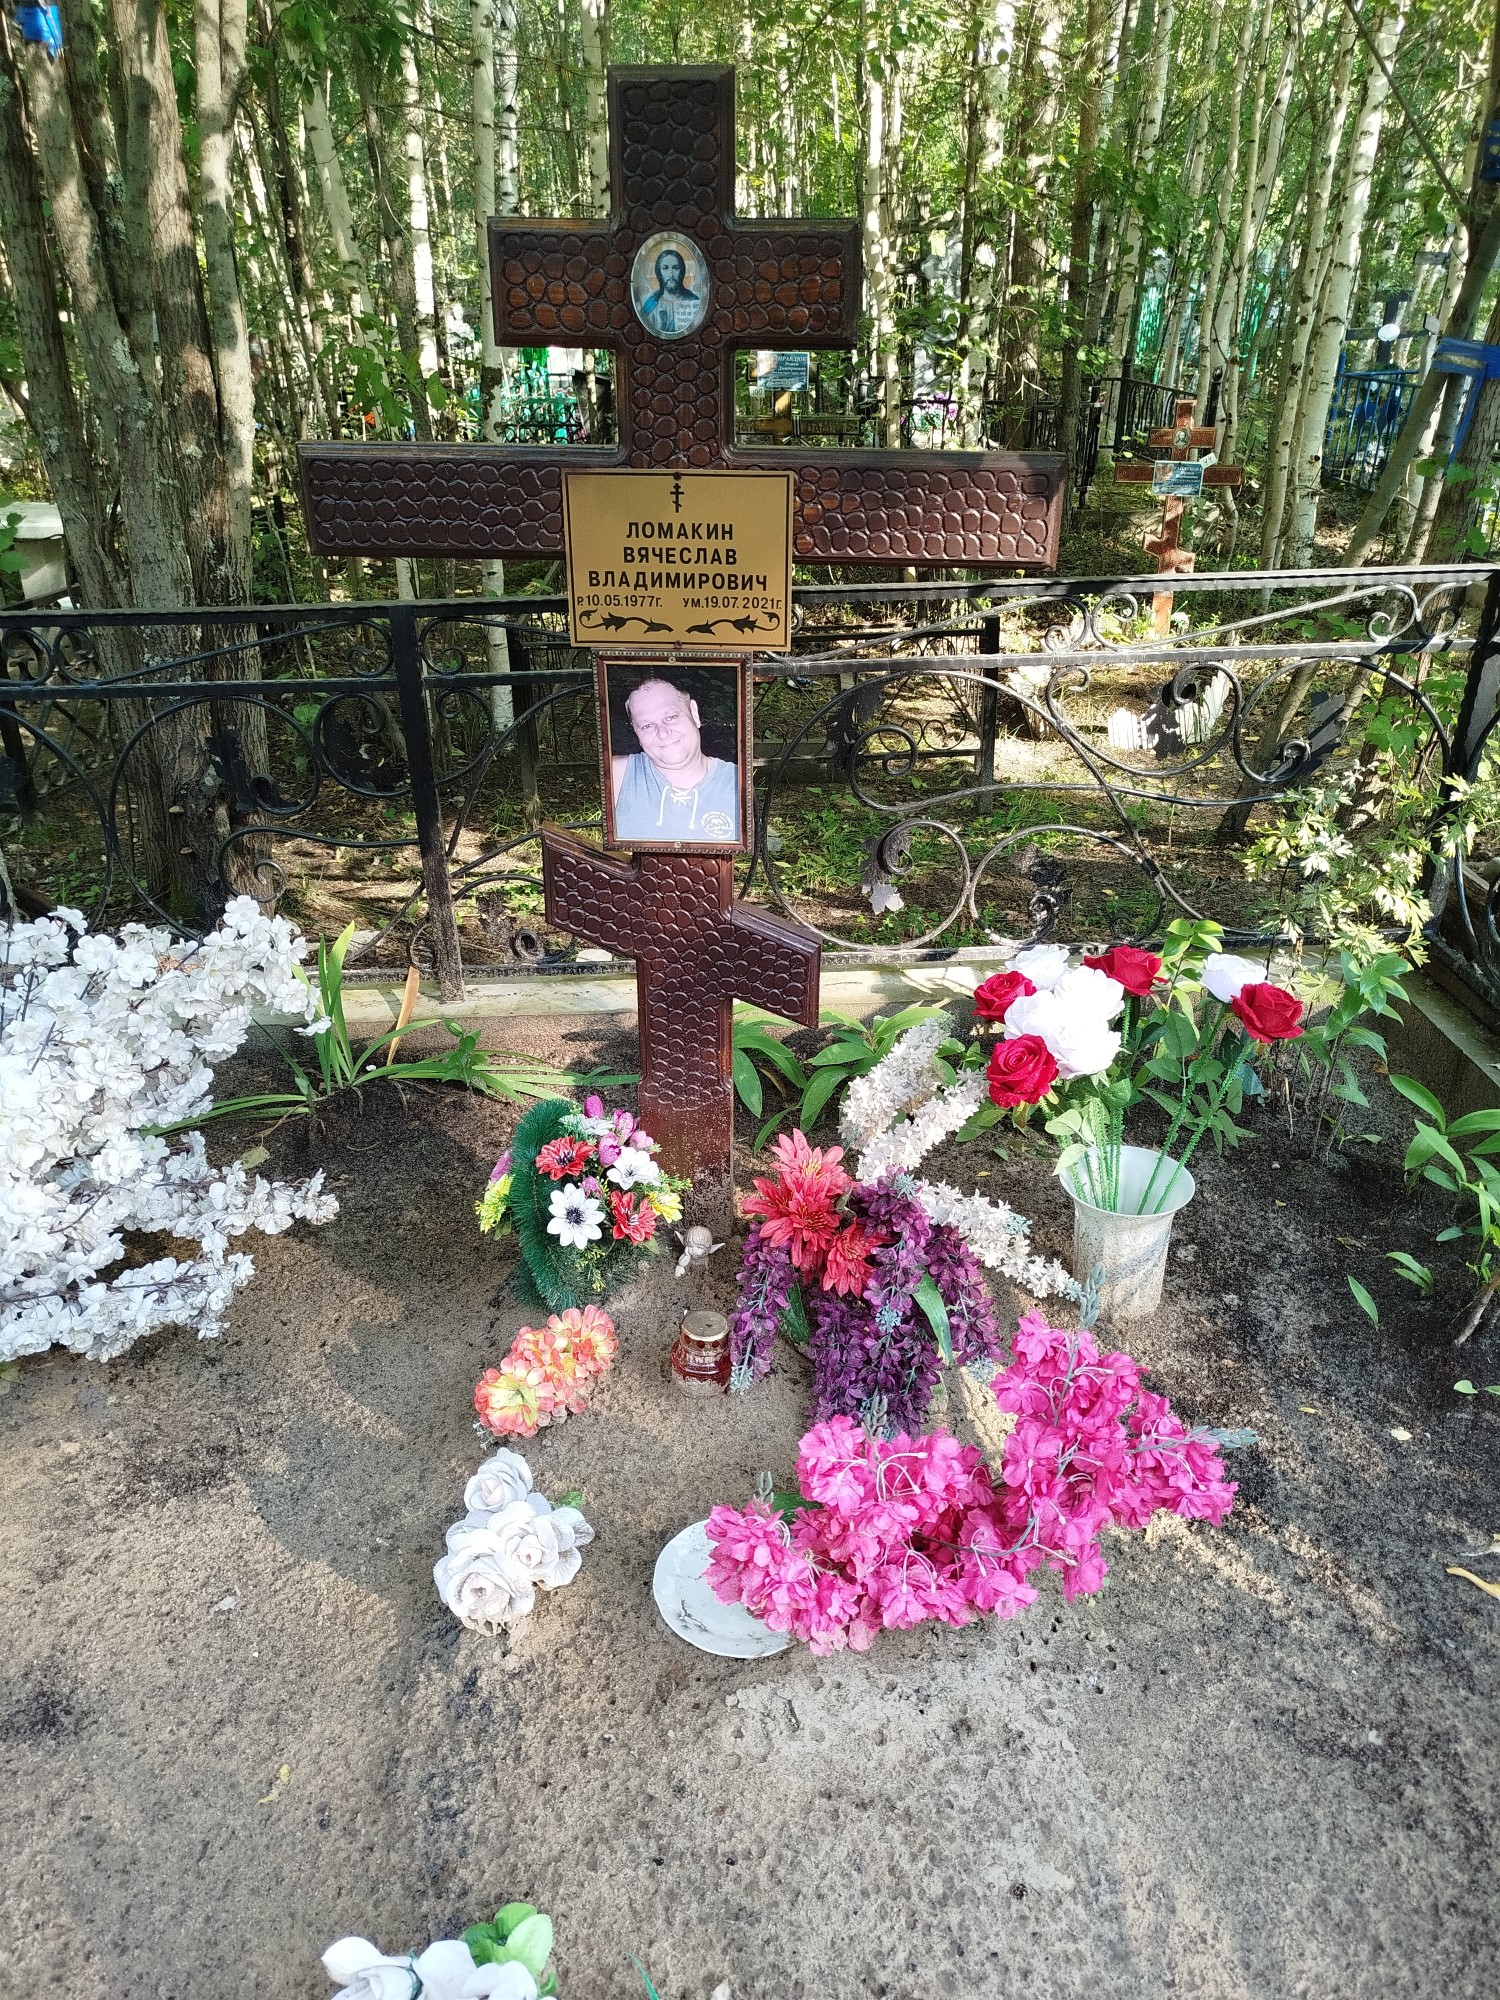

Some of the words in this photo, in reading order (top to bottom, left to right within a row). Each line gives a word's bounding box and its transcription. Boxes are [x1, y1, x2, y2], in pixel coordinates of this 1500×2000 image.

[626, 521, 734, 541] ЛОМАКИН
[623, 546, 737, 566] ВЯЧЕСЛАВ
[588, 570, 768, 592] ВЛАДИМИРОВИЧ
